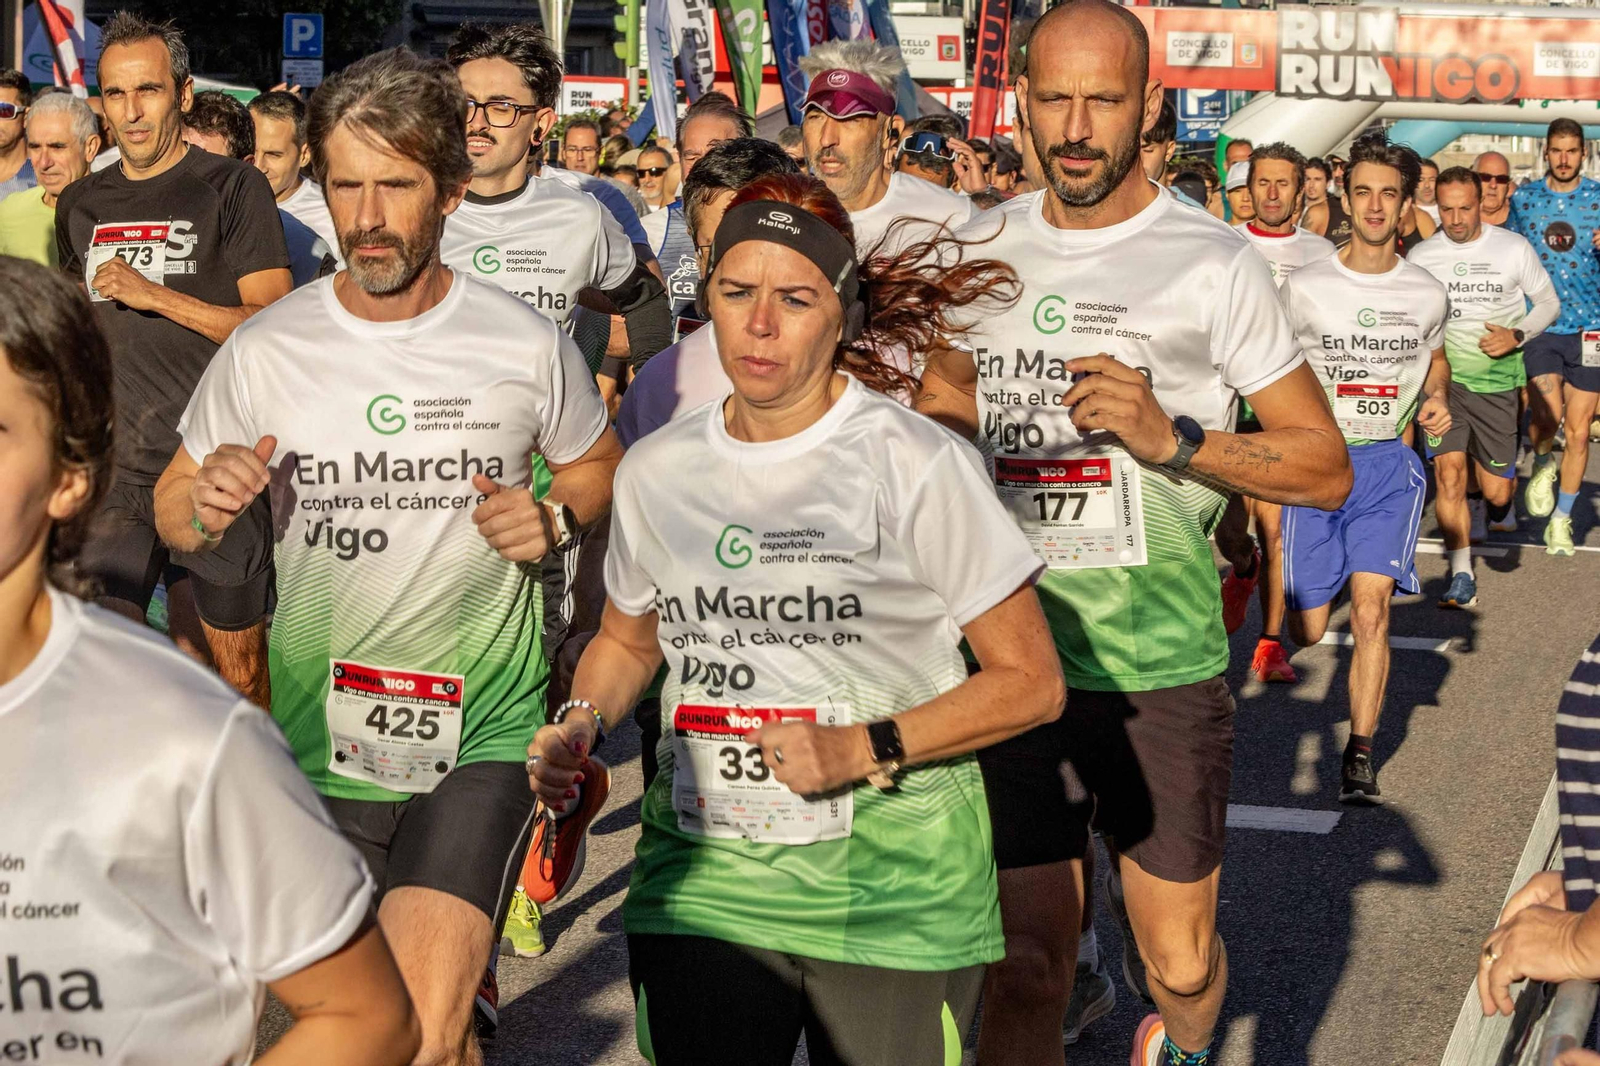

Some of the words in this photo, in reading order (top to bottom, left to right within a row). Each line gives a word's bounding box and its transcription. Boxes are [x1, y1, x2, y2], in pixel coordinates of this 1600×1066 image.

[292, 18, 315, 51] P
[1282, 10, 1394, 52] RUN
[901, 39, 930, 47] CELLO
[1172, 39, 1228, 49] CONCELLO
[1178, 50, 1192, 58] DE
[1196, 50, 1221, 59] VIGO
[1540, 49, 1596, 59] CONCELLO
[1546, 60, 1559, 68] DE
[1563, 60, 1589, 69] VIGO
[571, 91, 592, 99] RUN
[506, 249, 547, 257] asociación
[506, 257, 542, 265] española
[541, 267, 566, 275] cáncer
[1448, 280, 1503, 293] Marcha
[1075, 302, 1128, 314] asociación
[1073, 313, 1118, 325] española
[1071, 325, 1102, 336] contra
[1104, 326, 1113, 336] el
[1115, 328, 1152, 342] cáncer
[1322, 335, 1345, 350] En
[1351, 334, 1419, 351] Marcha
[1324, 353, 1356, 362] contra
[1359, 354, 1368, 363] el
[1324, 365, 1369, 382] Vigo
[413, 397, 472, 408] asociación
[1028, 389, 1047, 406] el
[414, 409, 464, 420] española
[1356, 400, 1390, 416] 503
[414, 421, 450, 431] contra
[453, 420, 462, 431] el
[465, 420, 501, 431] cáncer
[985, 411, 1044, 454] Vigo
[297, 453, 340, 485] En
[354, 448, 504, 483] Marcha
[300, 494, 364, 512] contra
[370, 493, 391, 510] el
[396, 493, 472, 510] cáncer
[1033, 491, 1089, 521] 177
[305, 517, 389, 561] Vigo
[763, 528, 825, 540] asociación
[1126, 534, 1134, 547] 177
[759, 540, 813, 552] española
[759, 553, 795, 565] contra
[798, 553, 809, 563] el
[694, 585, 863, 623] Marcha
[720, 629, 746, 650] el
[832, 632, 862, 646] en
[343, 671, 416, 692] UNRUNVIGO
[343, 685, 357, 695] Vigo
[366, 691, 392, 701] marcha
[393, 695, 417, 704] contra
[424, 699, 450, 707] cancro
[365, 704, 440, 740] 425
[679, 712, 763, 729] RUNRUNVIGO
[687, 729, 702, 739] Vigo
[711, 733, 740, 741] marcha
[719, 746, 770, 782] 33
[830, 801, 838, 818] 331
[12, 902, 80, 919] cáncer
[55, 1031, 103, 1058] en
